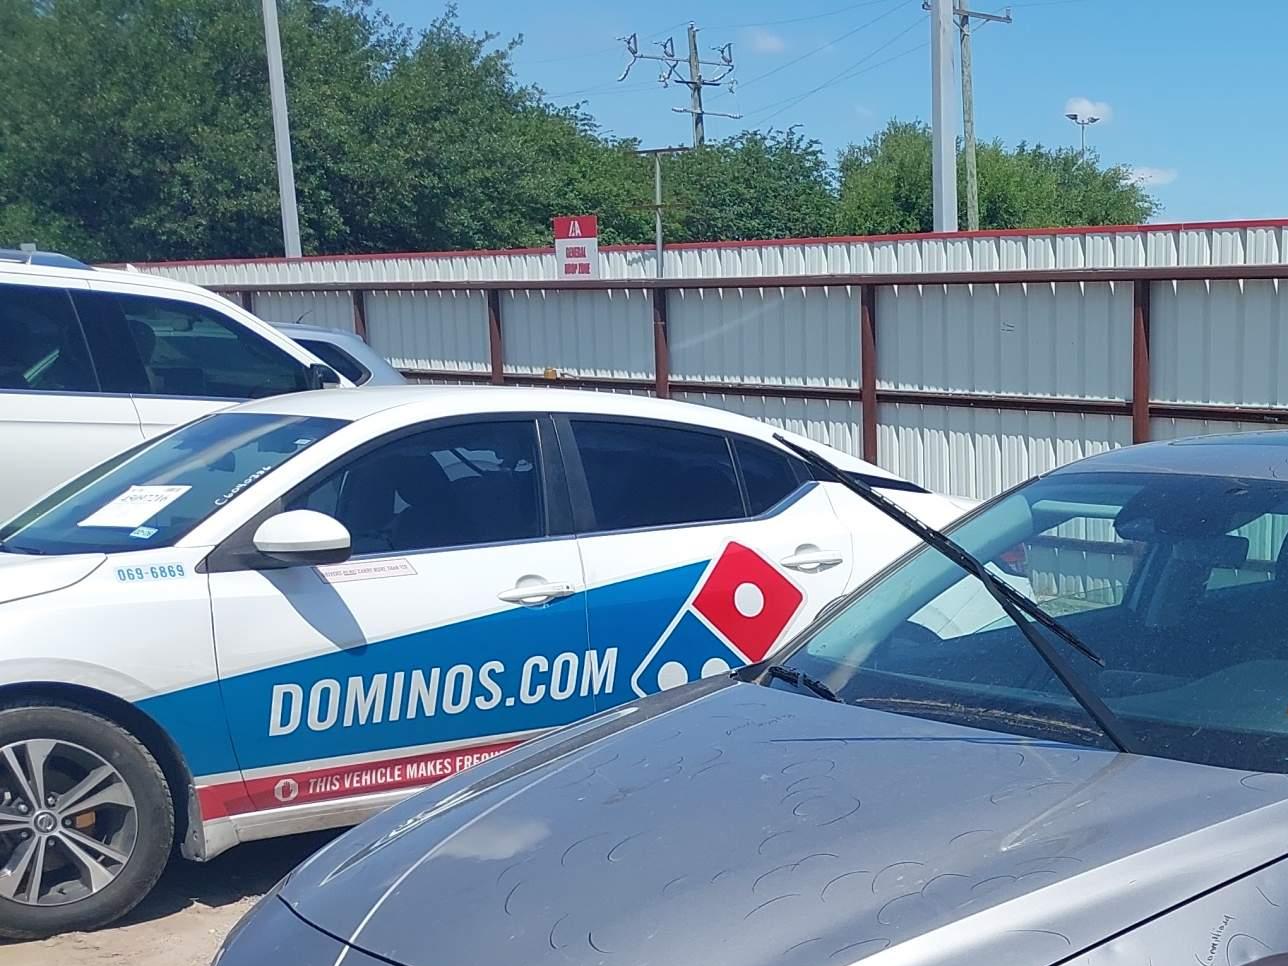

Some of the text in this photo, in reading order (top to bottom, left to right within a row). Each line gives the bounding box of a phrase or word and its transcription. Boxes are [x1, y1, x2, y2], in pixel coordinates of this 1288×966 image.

[117, 564, 185, 582] 069-6869
[268, 647, 620, 738] DOMINOS.COM
[307, 775, 341, 795] THIS
[344, 766, 402, 788] VEHICLE
[406, 758, 452, 780] MAKES
